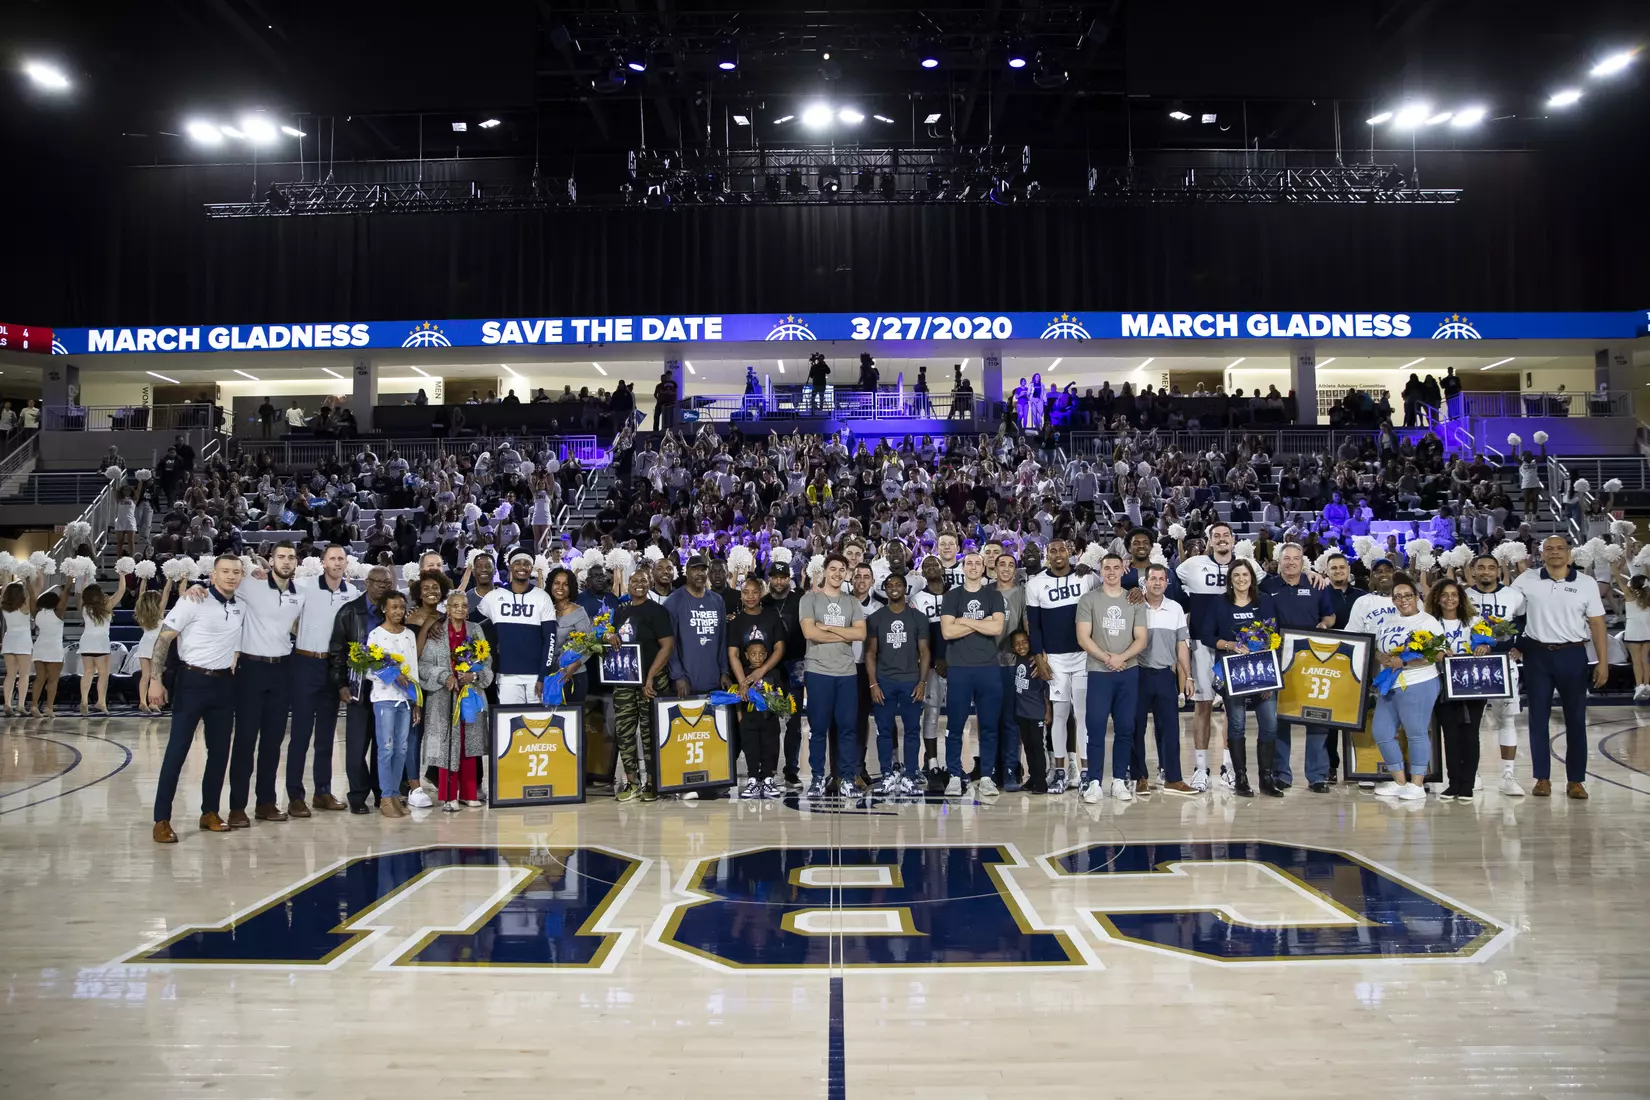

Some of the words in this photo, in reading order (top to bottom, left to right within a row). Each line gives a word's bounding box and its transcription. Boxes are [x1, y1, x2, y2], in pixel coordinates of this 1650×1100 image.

[481, 319, 563, 344] SAVE
[570, 318, 633, 342] THE
[641, 316, 723, 341] DATE
[850, 316, 1013, 340] 3/27/2020
[1121, 313, 1239, 337] MARCH
[1246, 313, 1412, 337] GLADNESS
[23, 328, 29, 338] 4
[88, 327, 200, 352] MARCH
[208, 323, 370, 350] GLADNESS
[434, 380, 442, 400] MEN
[942, 573, 965, 585] BU
[1205, 573, 1227, 587] CB
[1048, 583, 1082, 602] CBU
[1564, 586, 1578, 594] CBU
[501, 603, 535, 617] CBU
[690, 609, 718, 619] THREE
[925, 604, 942, 618] CB
[1232, 612, 1254, 620] CBU
[1365, 606, 1396, 620] TEAM
[689, 618, 719, 627] STRIPE
[696, 626, 715, 635] LIFE
[1445, 630, 1463, 639] AM
[545, 632, 556, 667] LANCERS
[1300, 666, 1342, 678] LANCERS
[1308, 676, 1331, 699] 33
[677, 731, 711, 742] LANCERS
[518, 743, 558, 754] LANCERS
[685, 741, 704, 765] 35
[526, 753, 549, 777] 32
[118, 839, 1518, 975] CBU
